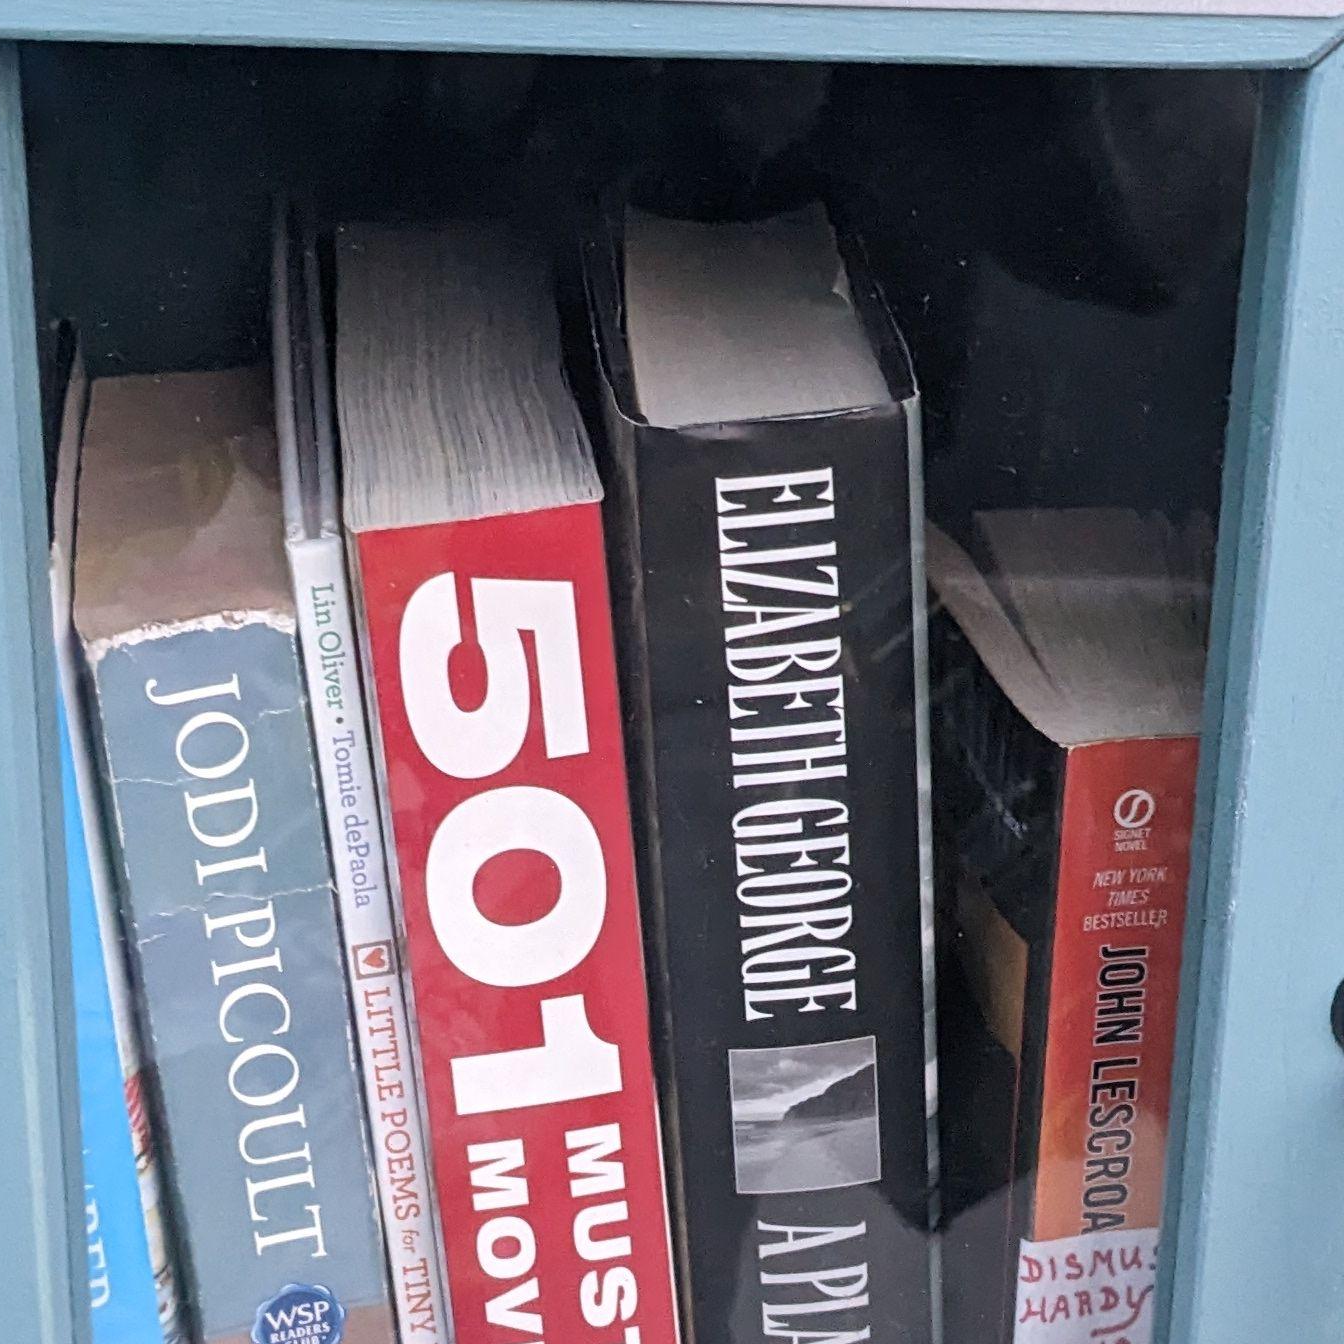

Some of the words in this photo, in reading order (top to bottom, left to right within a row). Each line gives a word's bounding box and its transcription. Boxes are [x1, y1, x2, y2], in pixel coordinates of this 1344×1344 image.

[311, 583, 336, 626] Lin
[715, 467, 848, 789] ELIZABETH
[318, 631, 345, 708] Oliver
[145, 673, 268, 885] JODI
[332, 730, 356, 808] Tomie
[344, 813, 378, 909] dePaola
[399, 570, 623, 1116] 501
[1093, 869, 1125, 888] NEW
[1129, 867, 1168, 884] YORK
[731, 797, 857, 1021] GEORGE
[1083, 909, 1168, 932] BESTSELLER
[1108, 889, 1150, 906] TIMES
[1093, 944, 1149, 1047] JOHN
[204, 900, 328, 1258] PICOULT
[364, 986, 404, 1101] LITTLE
[381, 1108, 421, 1220] POEMS
[402, 1229, 421, 1254] for
[757, 1220, 867, 1259] A
[265, 1300, 330, 1331] WSP
[270, 1321, 331, 1344] READERS
[402, 1257, 436, 1335] TINY
[1019, 1284, 1154, 1337] HARDY
